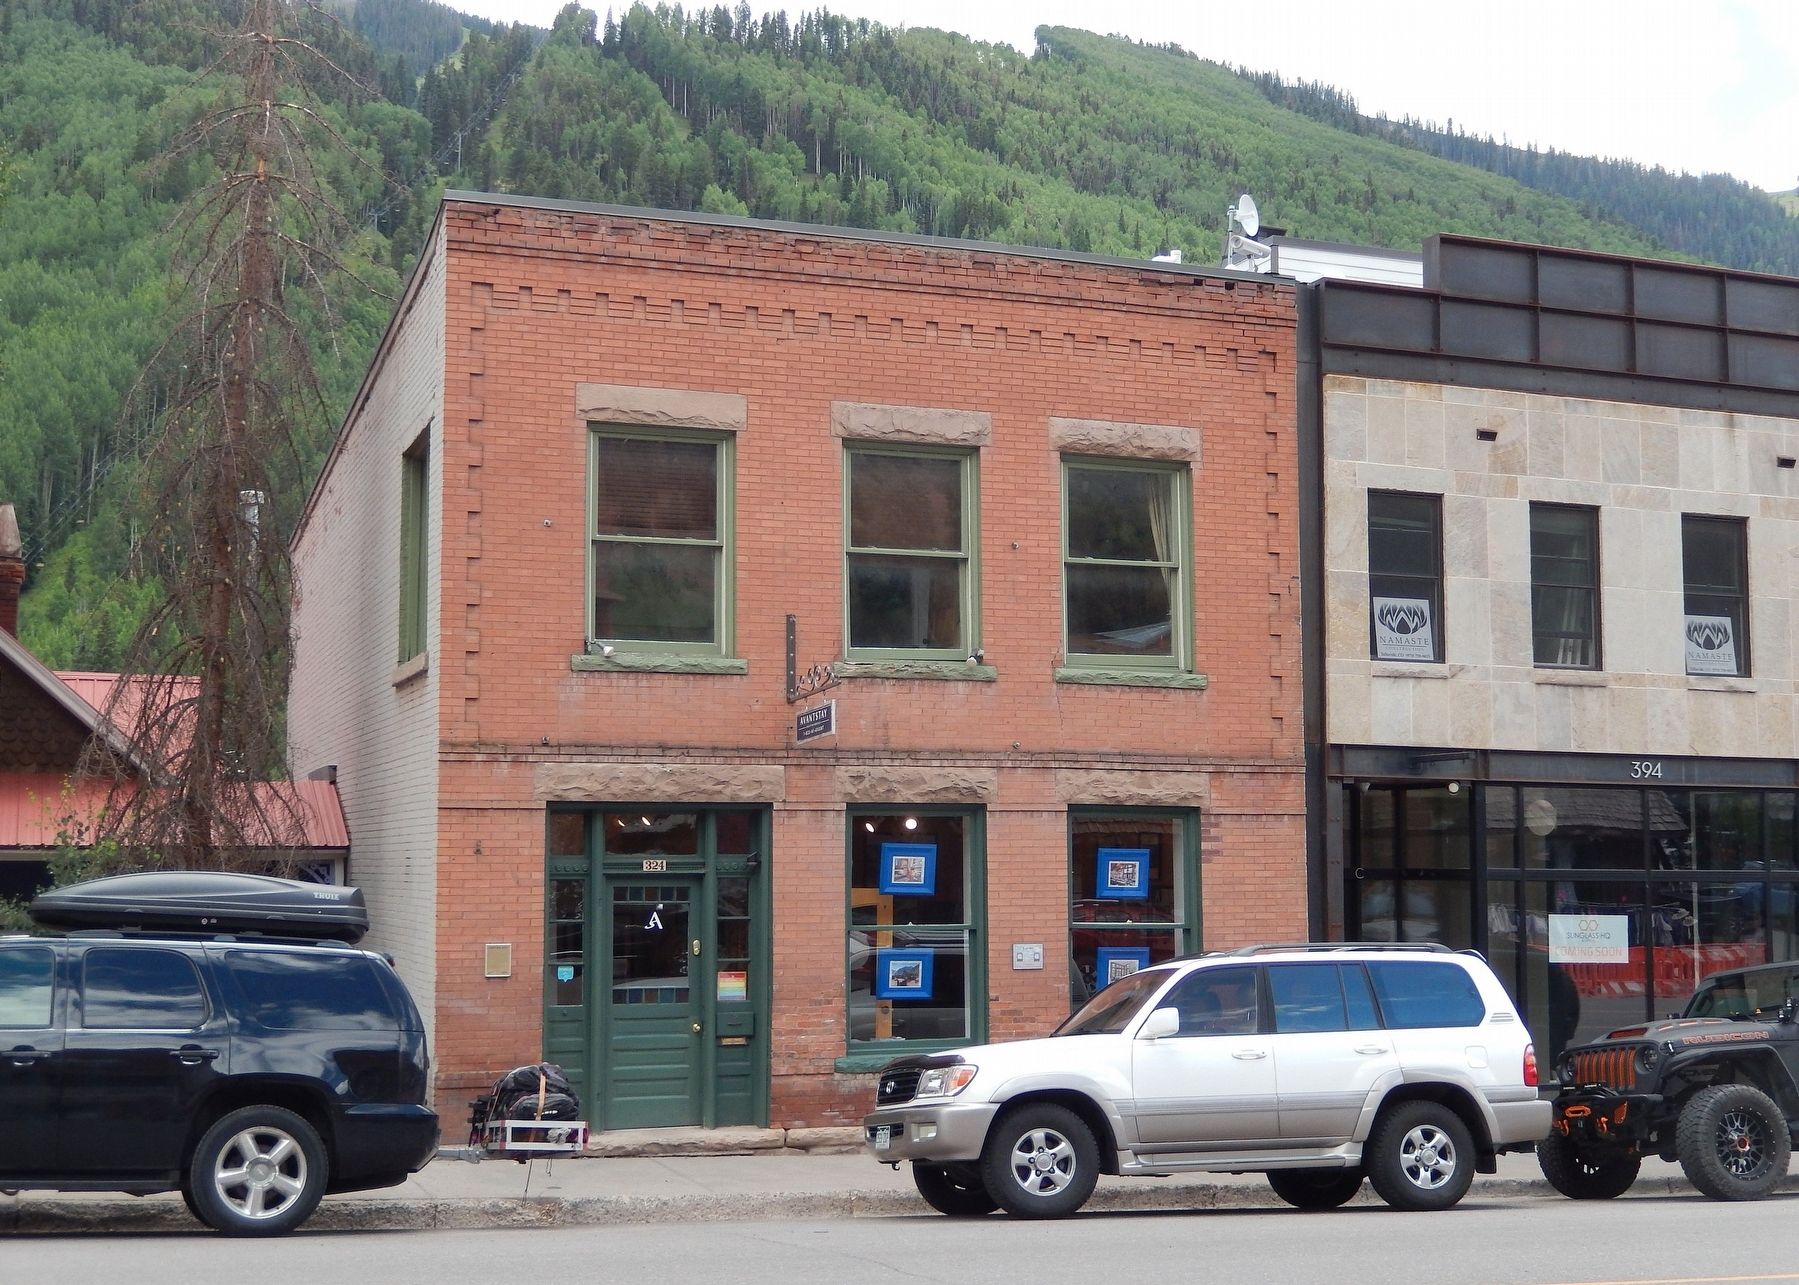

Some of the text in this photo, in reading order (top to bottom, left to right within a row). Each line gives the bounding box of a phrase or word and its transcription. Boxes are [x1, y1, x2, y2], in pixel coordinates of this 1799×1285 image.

[1379, 635, 1430, 646] NAMASTE
[1687, 651, 1733, 661] NAMASTE
[800, 708, 828, 726] AVANTSTAY
[1630, 761, 1663, 779] 394
[645, 860, 665, 871] 324
[313, 891, 340, 901] THULE
[644, 911, 663, 930] A
[1567, 931, 1611, 940] SUNGLASS HQ
[1554, 946, 1622, 958] COMING SOON
[1682, 1031, 1770, 1045] RUBICON
